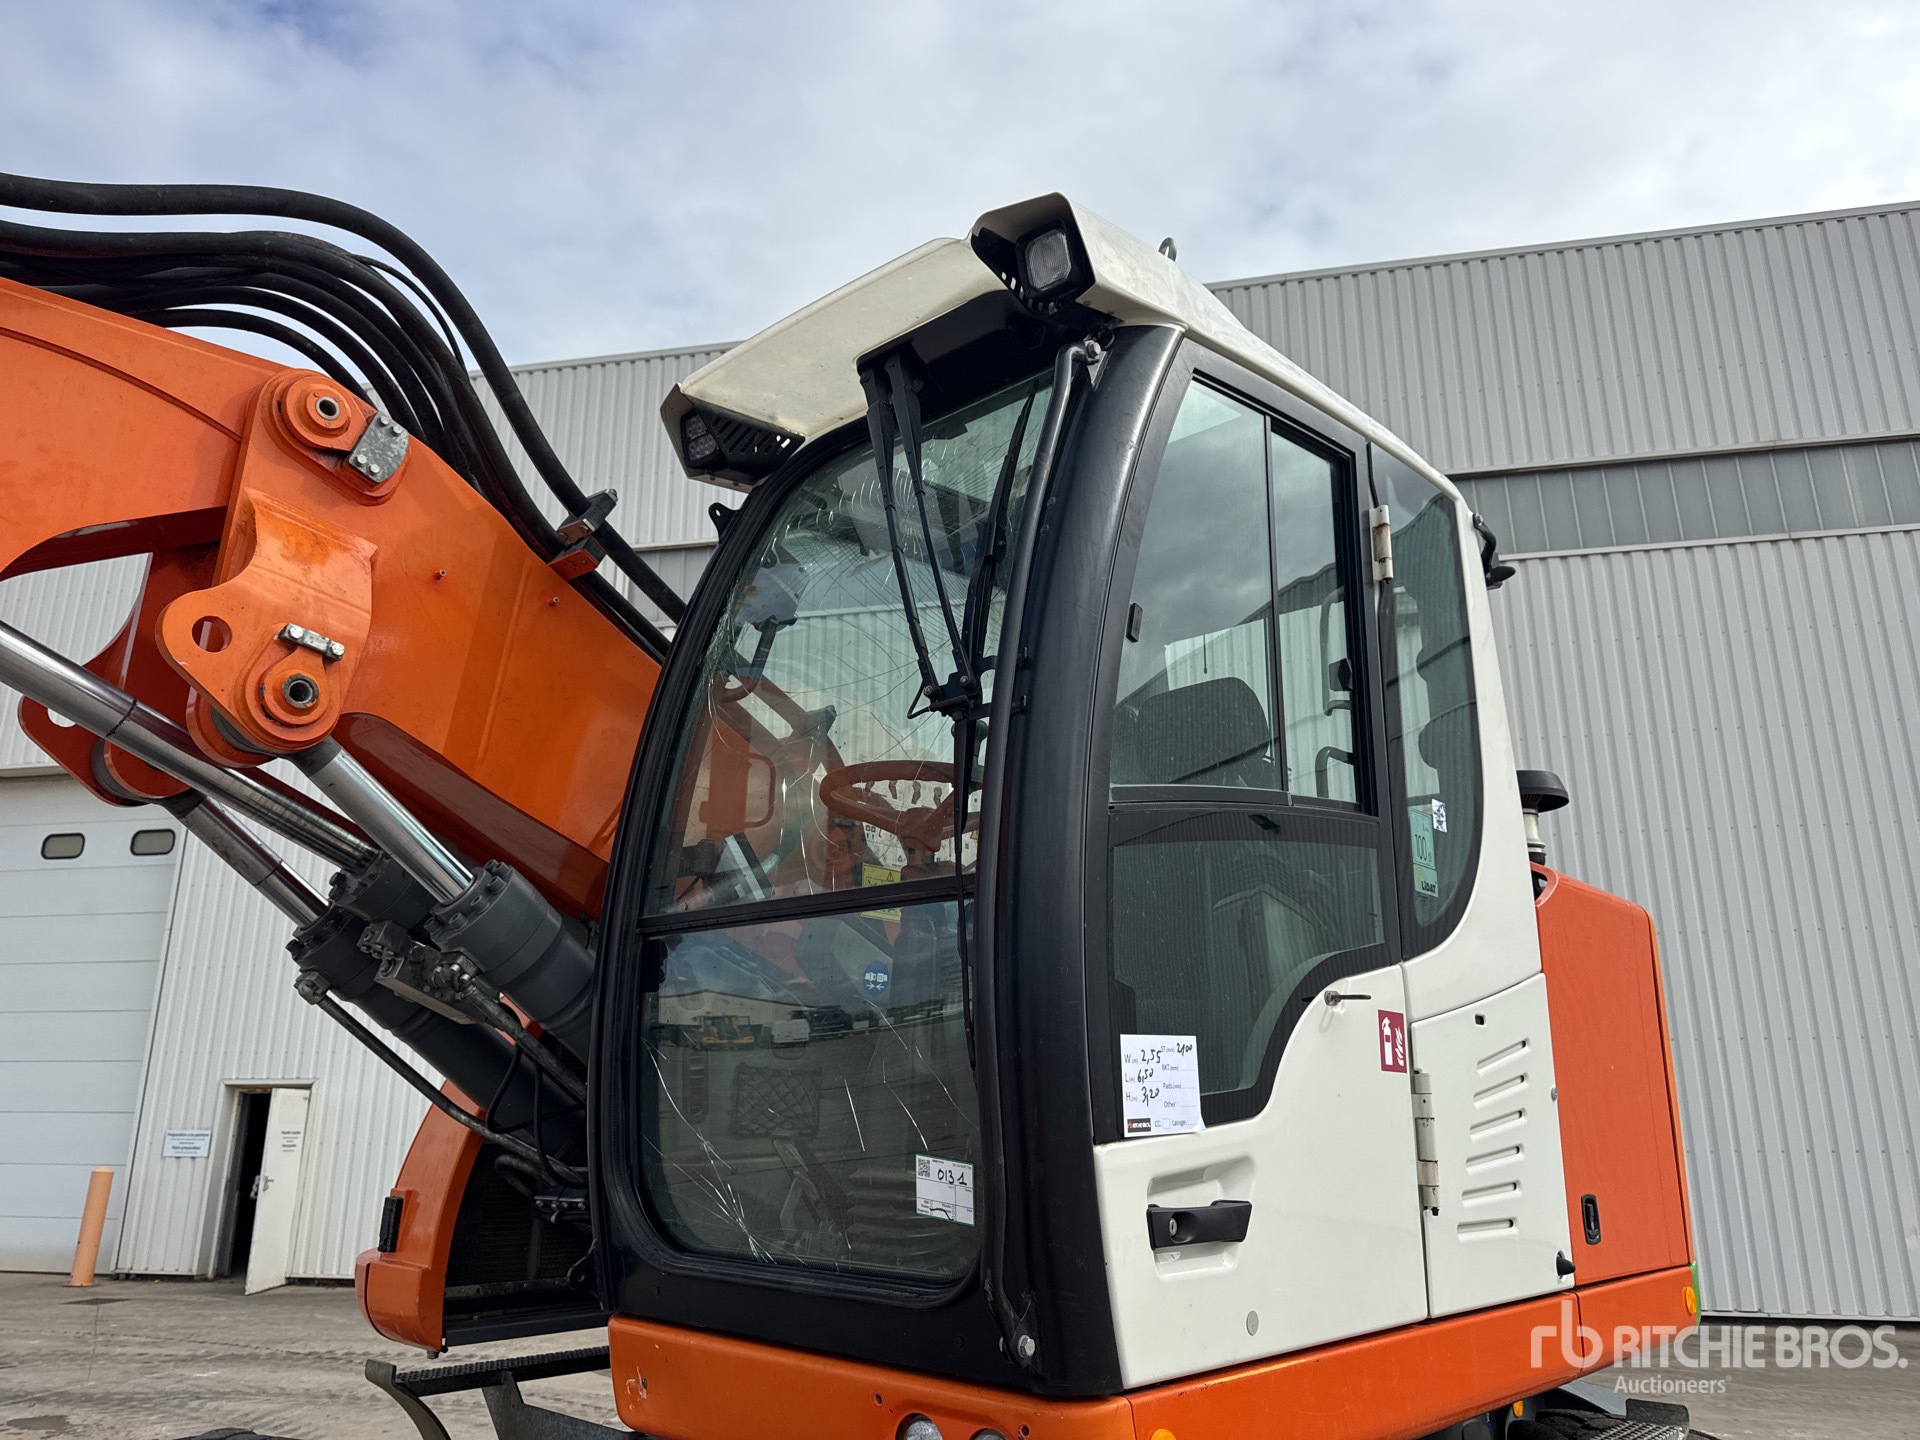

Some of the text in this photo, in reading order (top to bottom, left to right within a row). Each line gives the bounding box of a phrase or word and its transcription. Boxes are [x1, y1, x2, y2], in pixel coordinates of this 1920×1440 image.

[1140, 1048, 1162, 1066] 2,55
[1137, 1067, 1154, 1085] 6,50
[1141, 1086, 1160, 1107] 3,20
[937, 1168, 967, 1186] 0131
